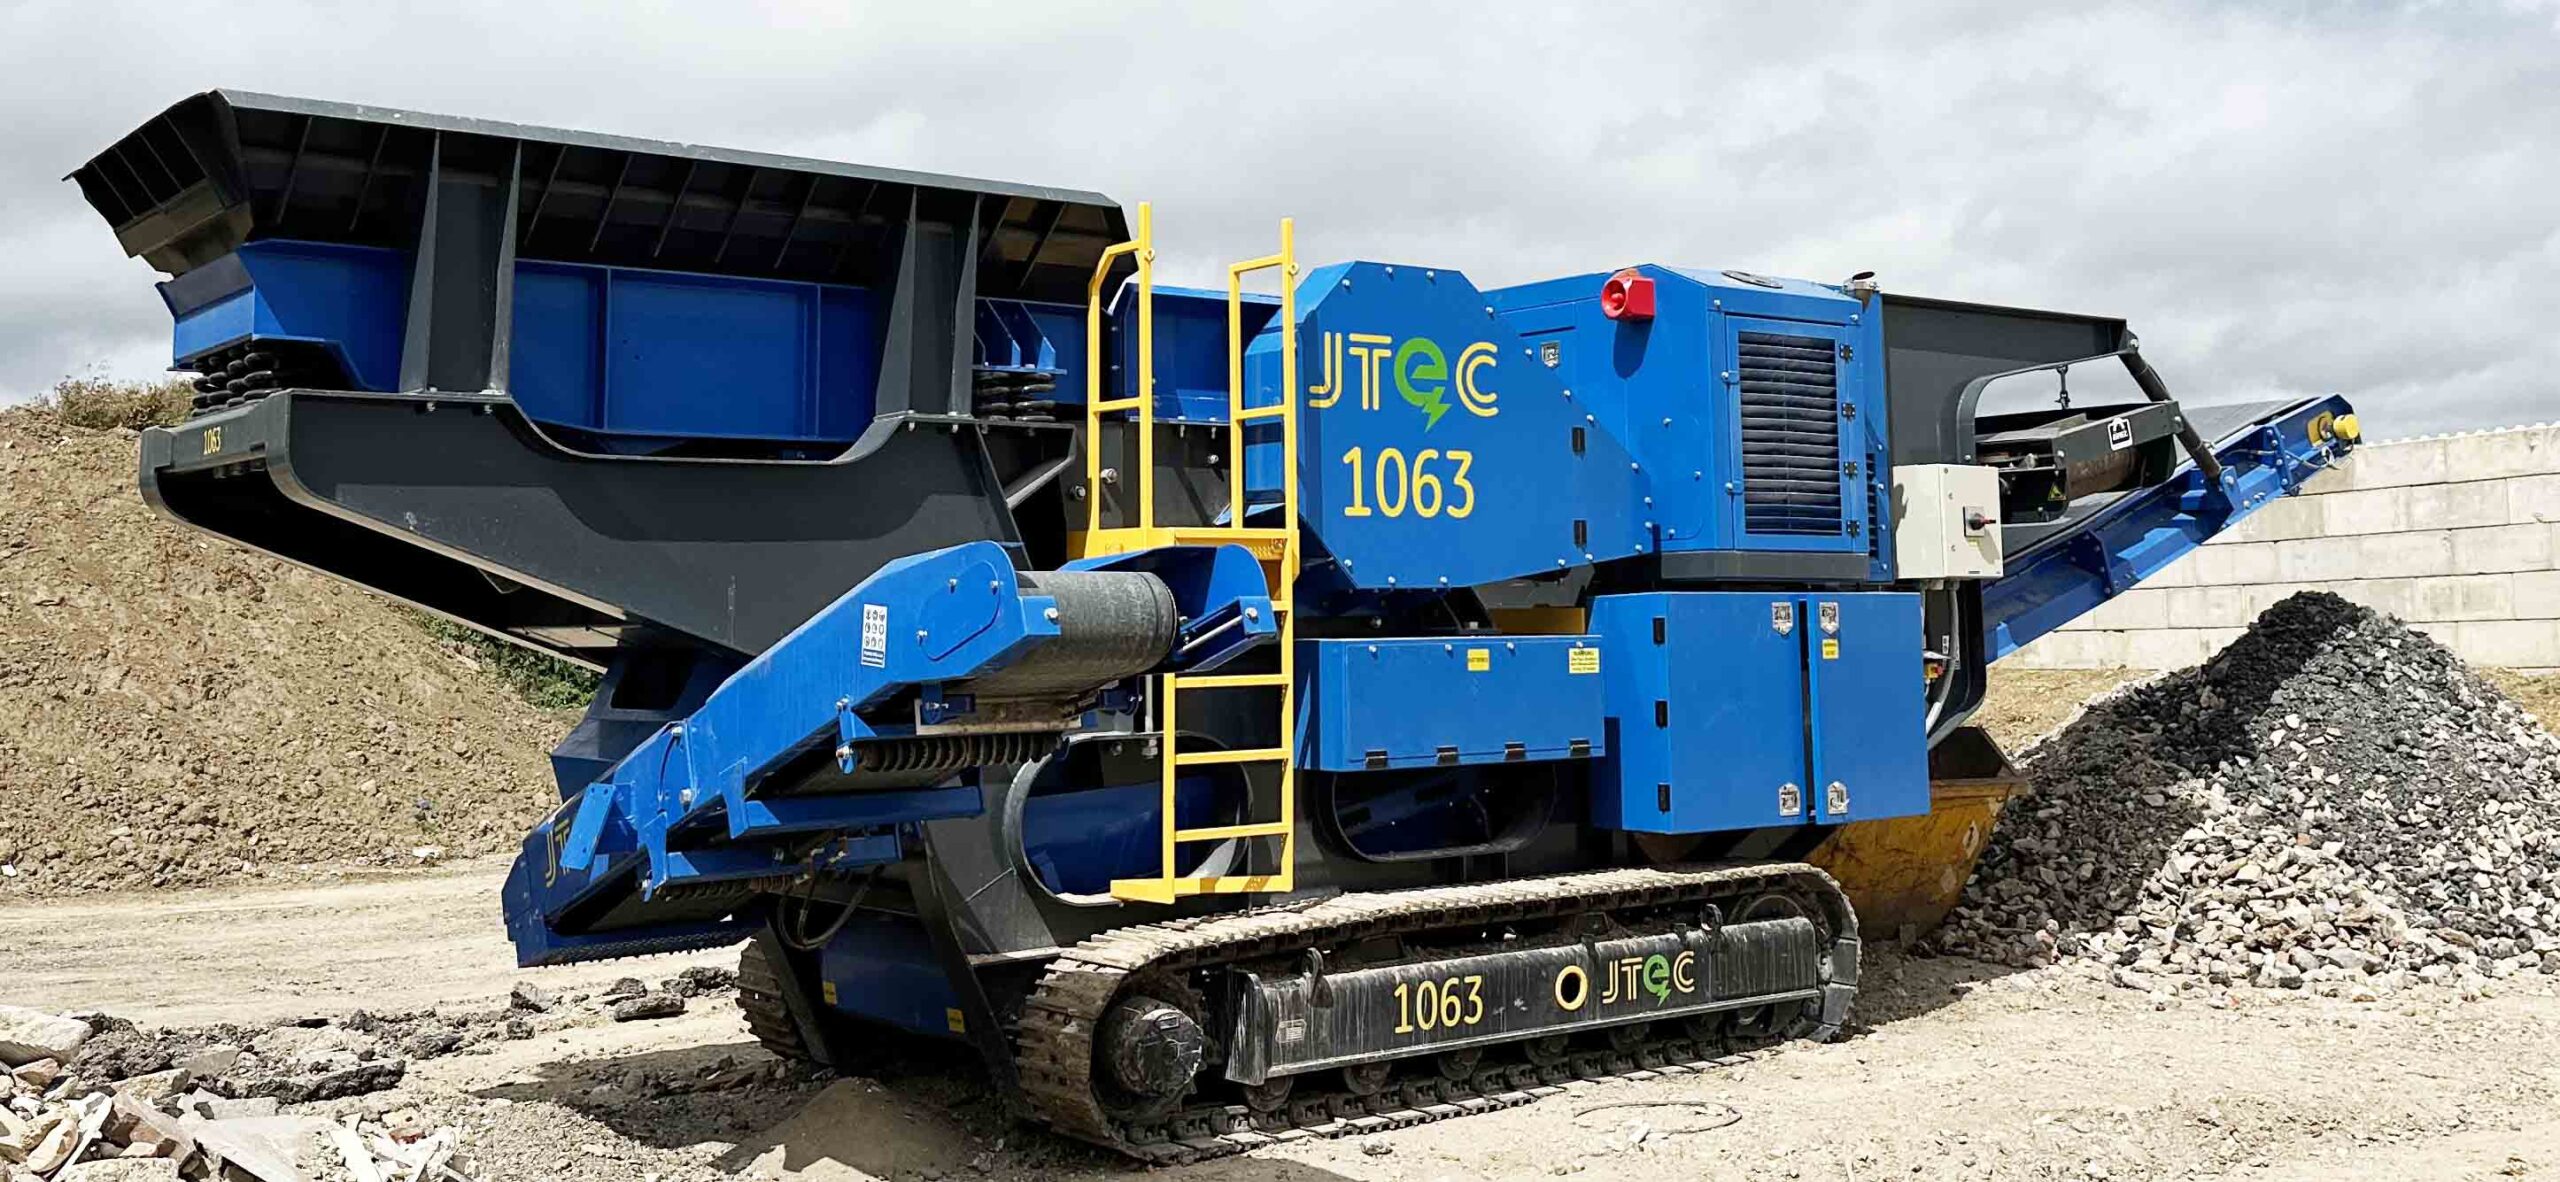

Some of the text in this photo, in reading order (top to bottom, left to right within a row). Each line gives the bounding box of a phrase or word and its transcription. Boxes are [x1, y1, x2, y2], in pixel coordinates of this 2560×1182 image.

[203, 426, 221, 455] 1063
[1342, 446, 1475, 518] 1063
[1393, 975, 1483, 1034] 1063
